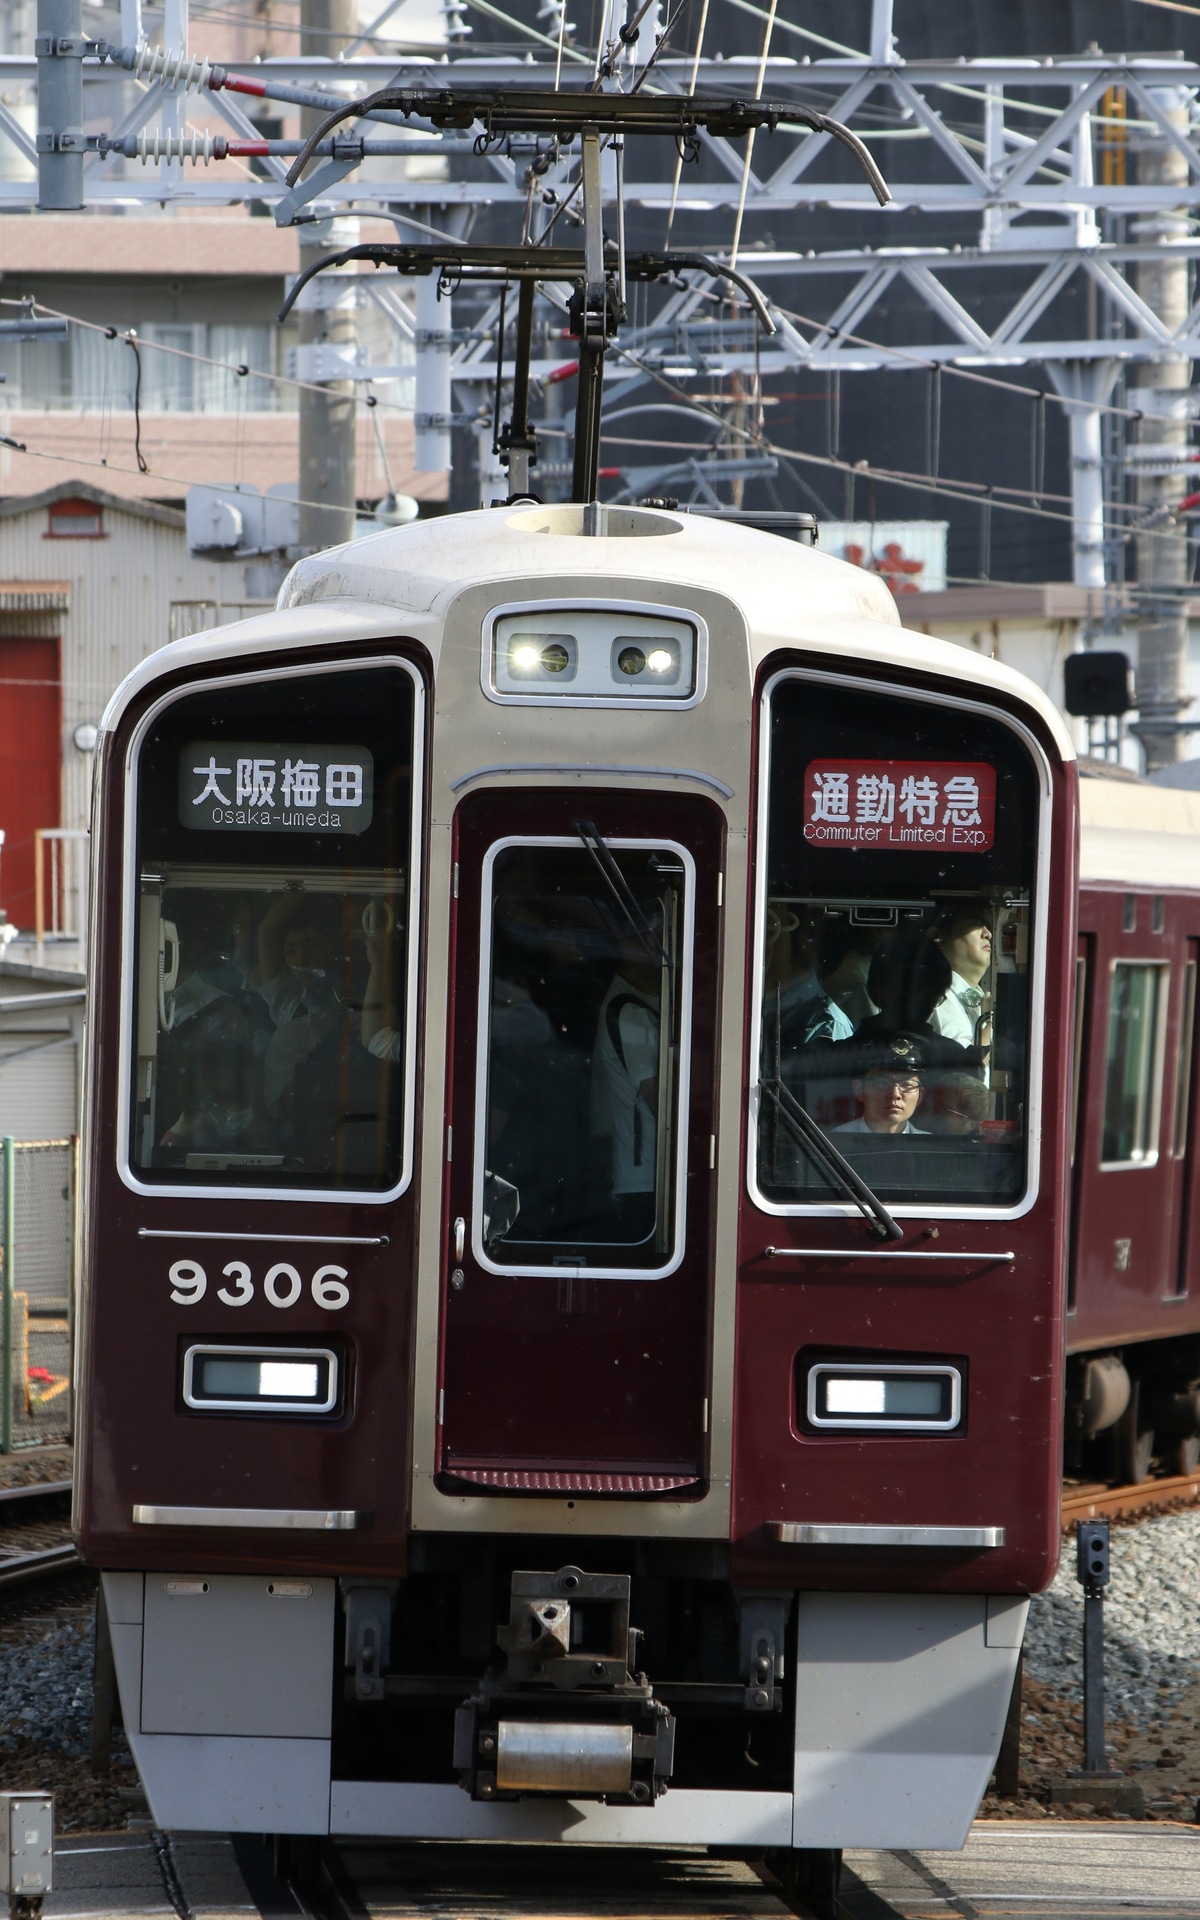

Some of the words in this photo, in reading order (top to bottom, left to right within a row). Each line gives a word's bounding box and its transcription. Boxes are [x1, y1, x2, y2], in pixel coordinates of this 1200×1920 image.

[192, 756, 363, 808] 大阪梅田
[810, 772, 983, 826] 通勤特急
[212, 807, 342, 828] Osaka-umeda
[803, 823, 883, 842] Commuter
[889, 825, 946, 843] Limited
[952, 827, 988, 847] Exp.
[168, 1259, 350, 1311] 9306
